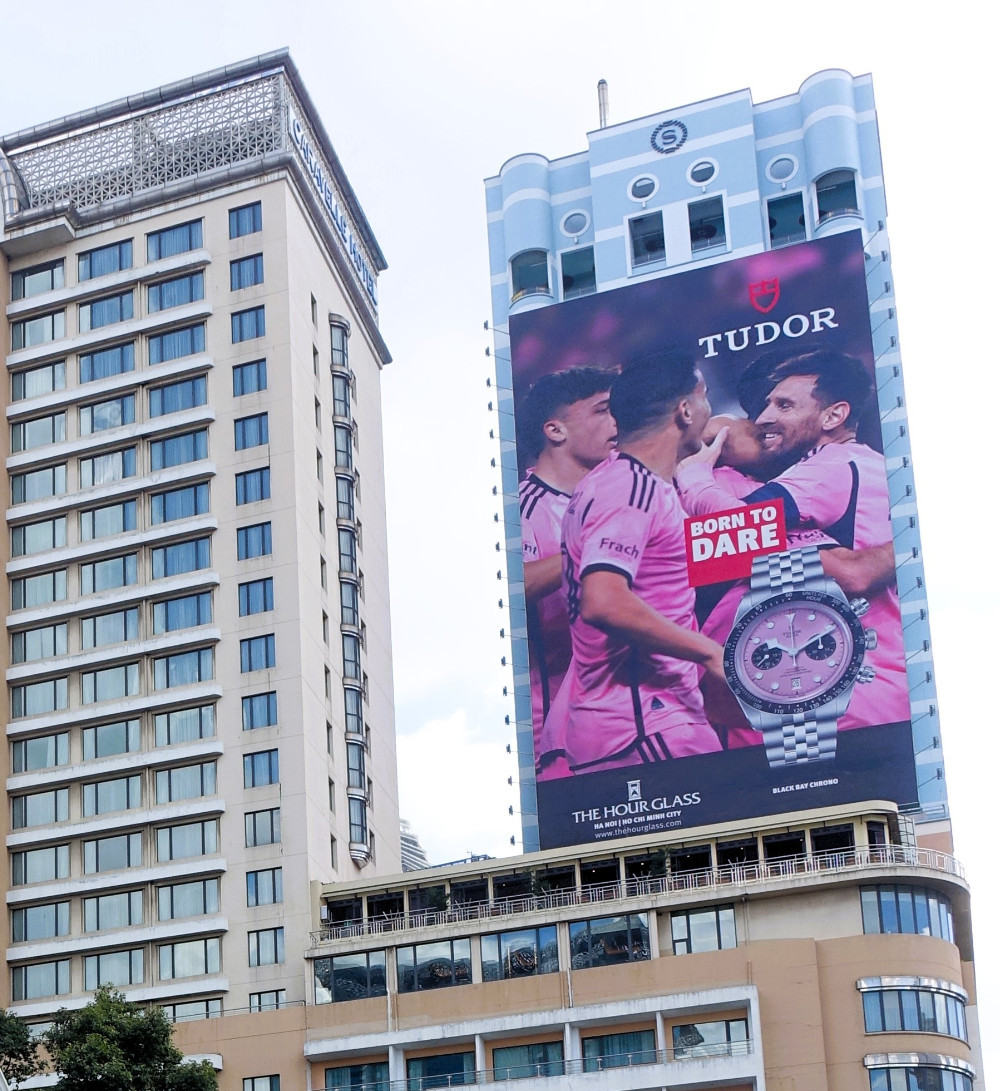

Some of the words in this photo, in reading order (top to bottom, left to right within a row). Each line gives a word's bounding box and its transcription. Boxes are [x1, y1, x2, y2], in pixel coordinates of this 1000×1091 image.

[292, 118, 348, 243] CARAVELLE
[349, 238, 378, 306] HOTEL
[698, 307, 839, 358] TUDOR
[691, 513, 745, 537] BORN
[750, 506, 777, 524] TO
[691, 523, 779, 563] DARE
[773, 785, 795, 794] BLACK
[810, 779, 839, 788] CHRONO
[572, 808, 601, 823] THE
[604, 801, 650, 819] HOUR
[651, 792, 701, 810] GLASS
[622, 818, 632, 826] HO
[646, 813, 665, 822] MINH
[666, 810, 682, 818] CITY
[595, 820, 682, 839] www.thehourglass.com
